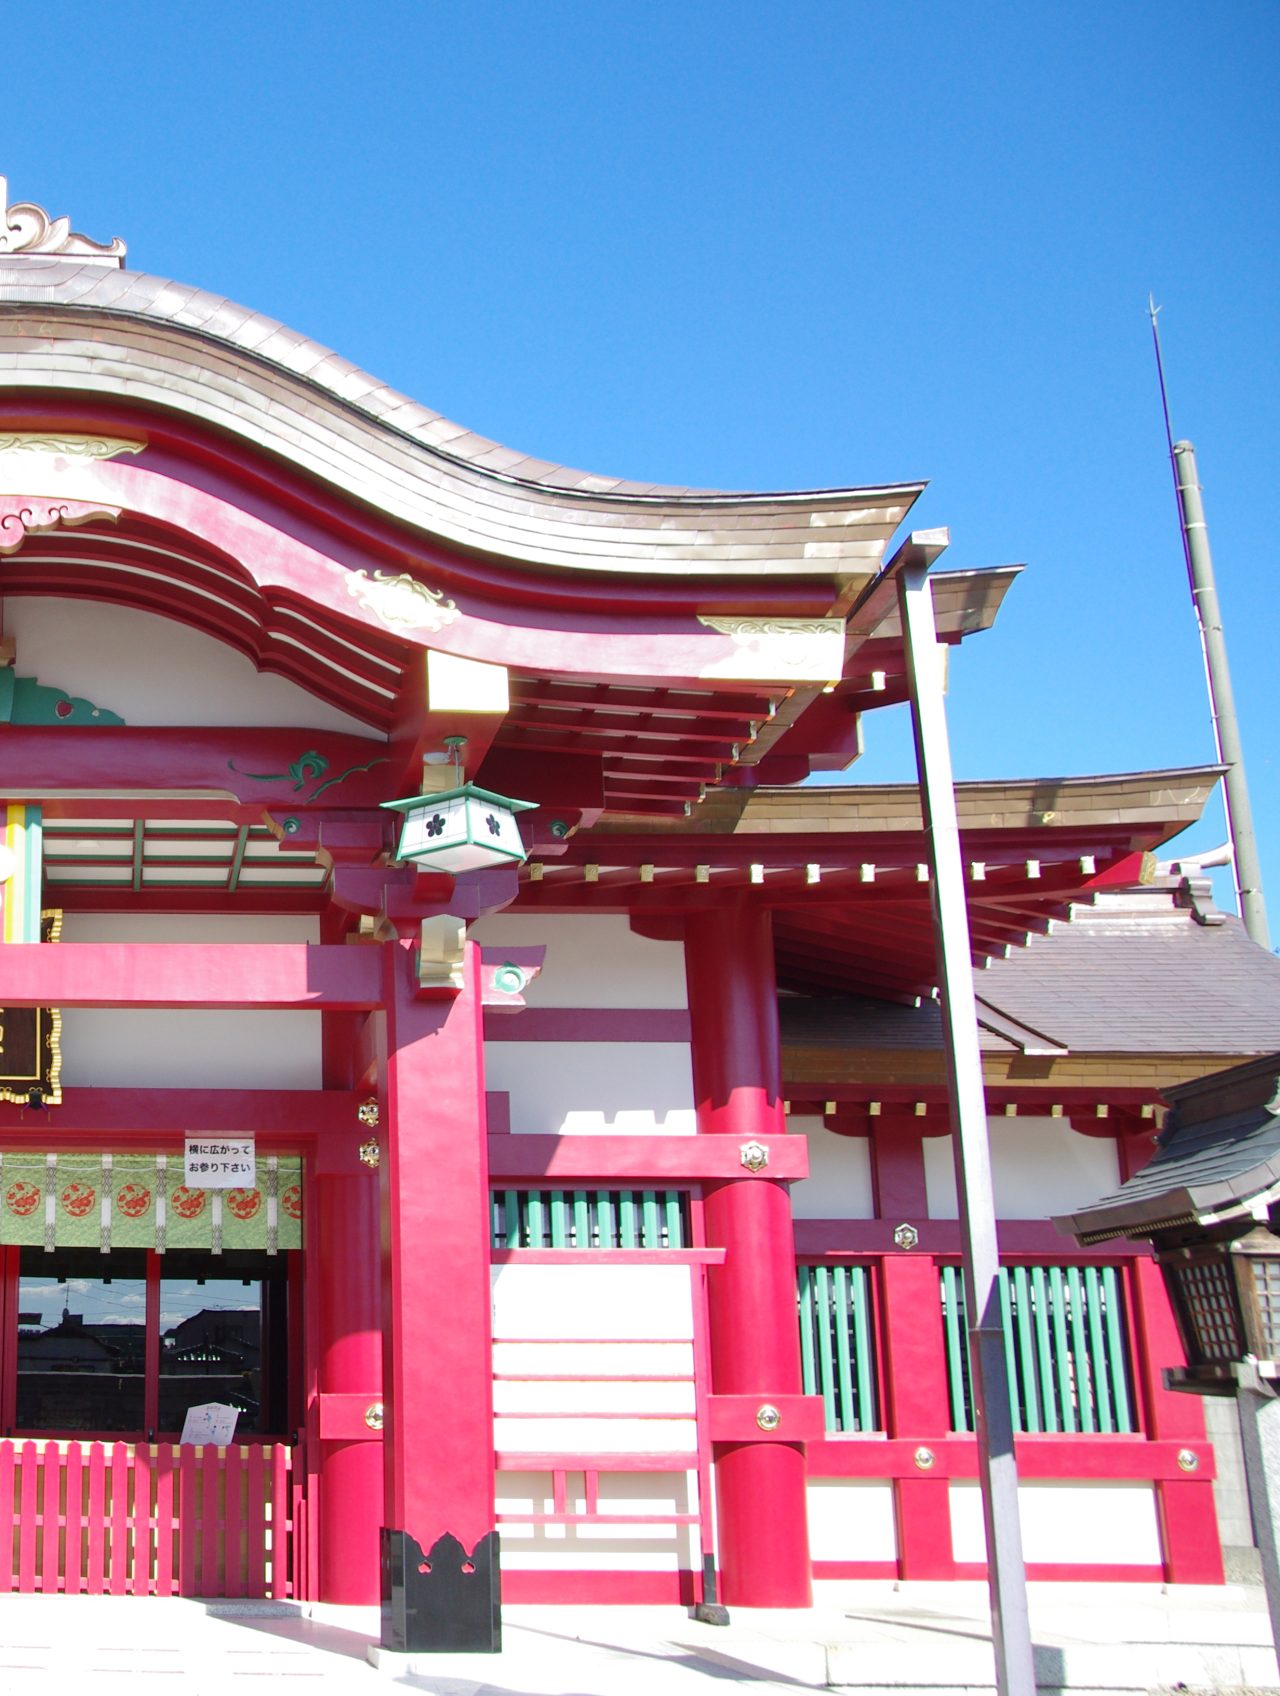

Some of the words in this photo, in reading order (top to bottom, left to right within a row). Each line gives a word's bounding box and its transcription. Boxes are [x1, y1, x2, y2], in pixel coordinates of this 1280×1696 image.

[189, 1144, 251, 1155] 横に広がって
[189, 1162, 251, 1173] お参り下さい
